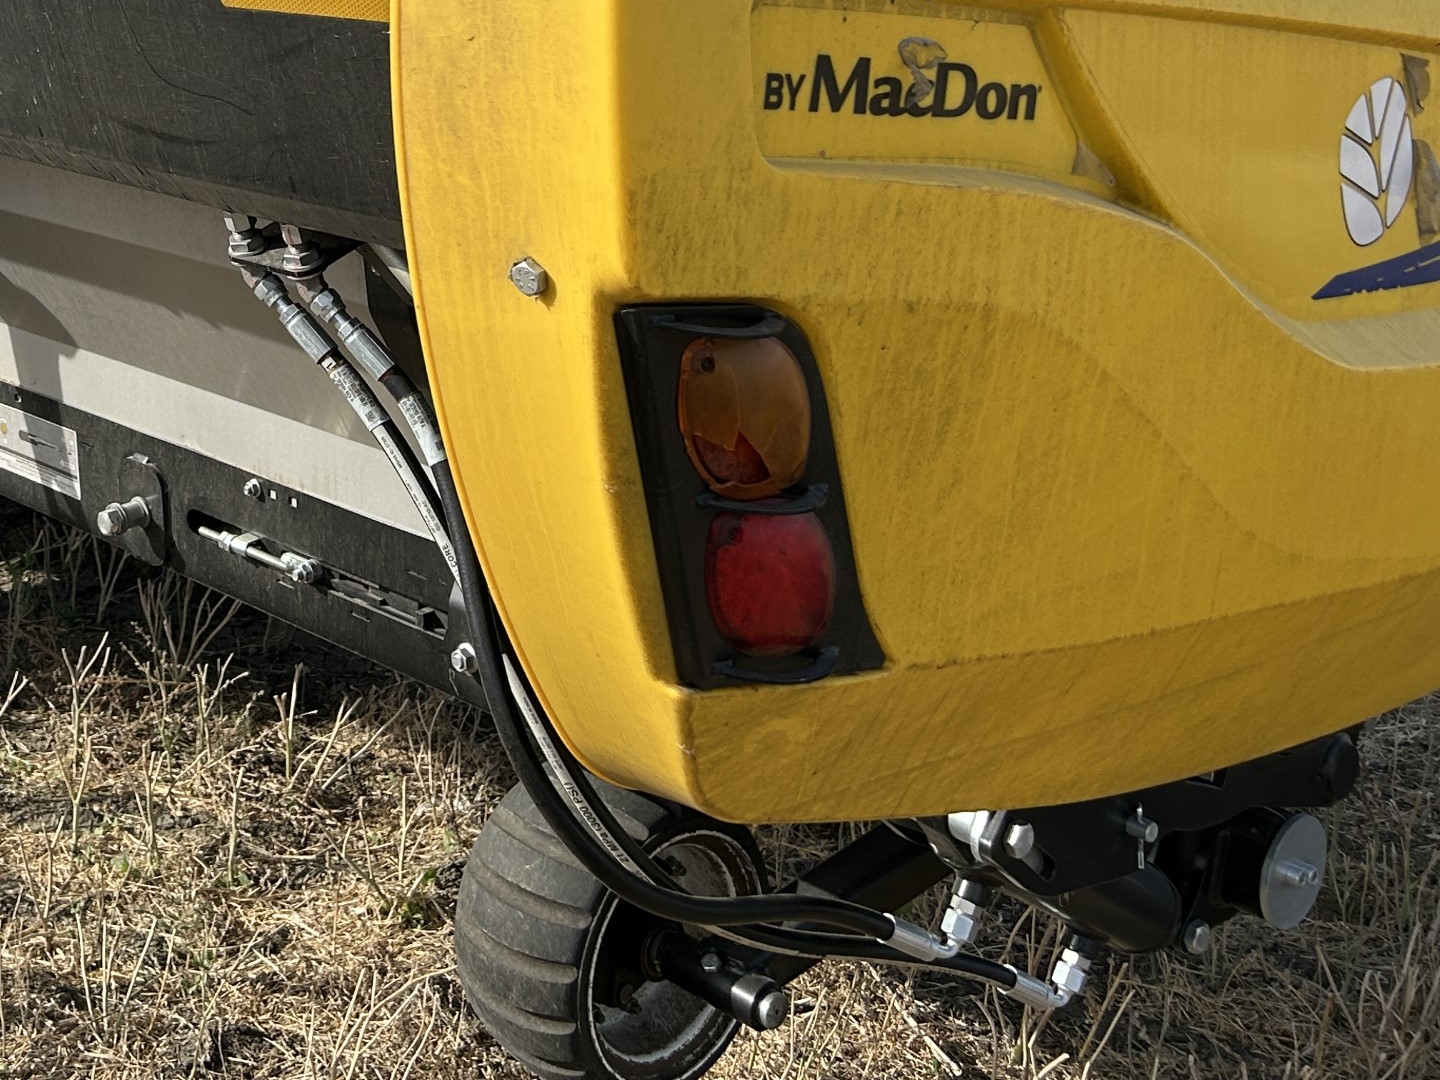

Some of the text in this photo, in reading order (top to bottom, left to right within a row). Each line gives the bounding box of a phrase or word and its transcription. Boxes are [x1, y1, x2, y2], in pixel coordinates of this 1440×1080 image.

[763, 72, 806, 111] BY
[578, 804, 603, 832] (3000
[599, 831, 619, 853] MPa
[616, 851, 629, 865] 21
